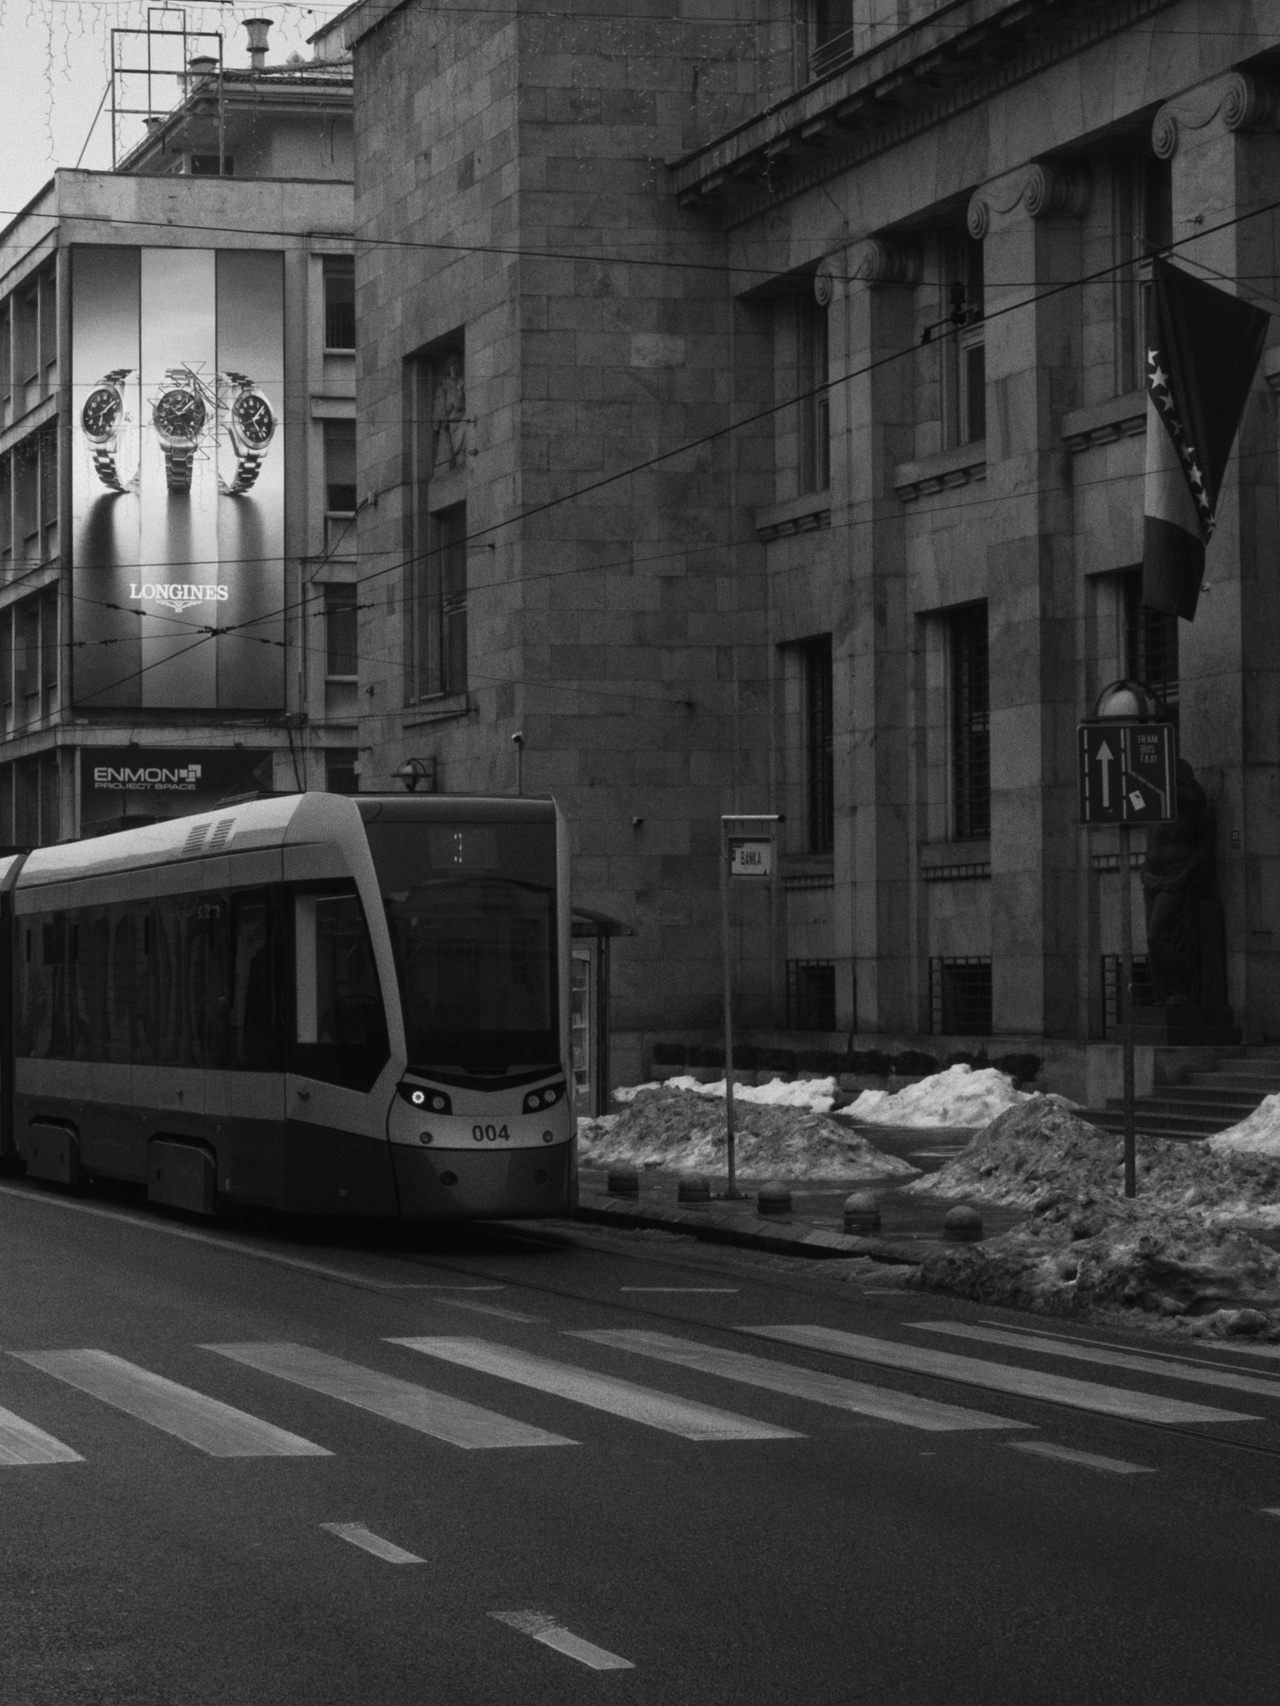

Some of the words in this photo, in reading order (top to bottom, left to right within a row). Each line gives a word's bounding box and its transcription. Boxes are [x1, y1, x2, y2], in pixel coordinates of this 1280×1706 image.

[129, 583, 229, 601] LONGINES
[1136, 734, 1158, 744] TRAM
[1140, 744, 1156, 754] BUS
[1140, 754, 1158, 764] TAXI
[94, 767, 178, 782] ENMON
[94, 782, 153, 790] PROJECT
[154, 783, 196, 791] SPACE
[740, 851, 762, 866] BANKA
[472, 1124, 510, 1142] 004
